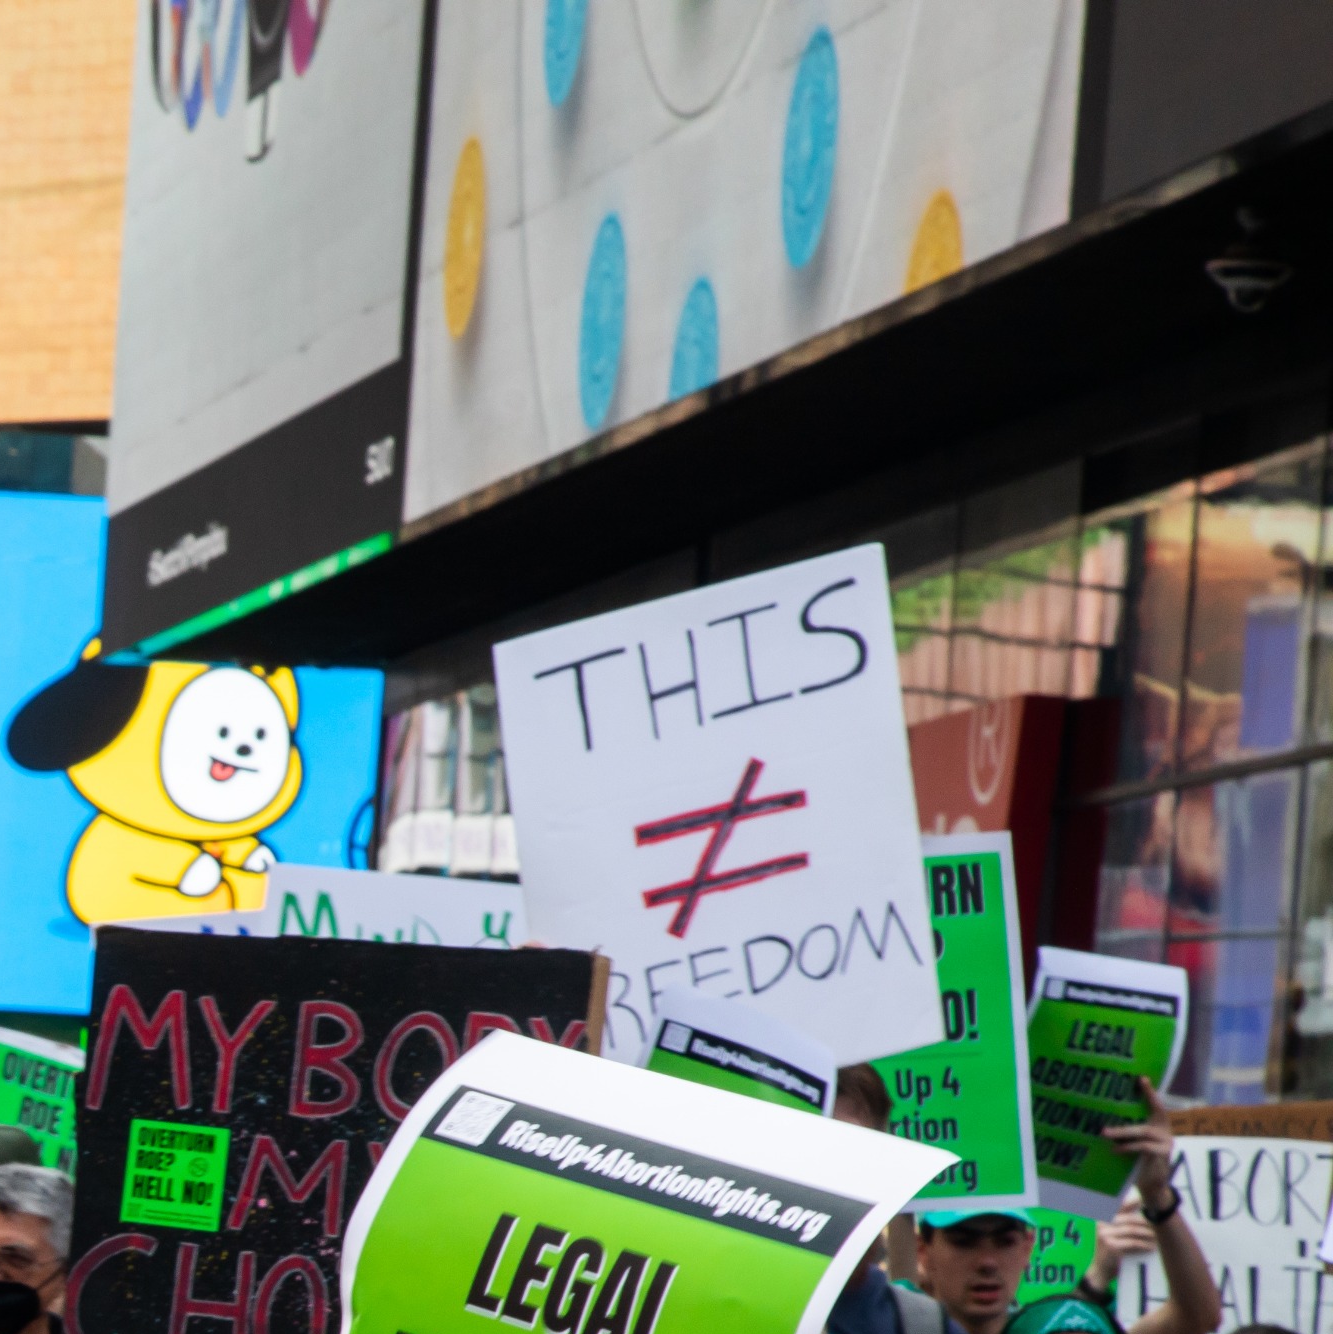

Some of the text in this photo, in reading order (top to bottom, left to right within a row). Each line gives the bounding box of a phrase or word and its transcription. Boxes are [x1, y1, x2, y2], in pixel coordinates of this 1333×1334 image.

[533, 575, 870, 752] THIS
[85, 984, 276, 1113] MY
[895, 1066, 961, 1106] Up 4
[132, 1173, 176, 1202] HELL
[499, 1120, 831, 1243] RiseUp4AbortionRights.org
[1064, 1219, 1081, 1246] 4
